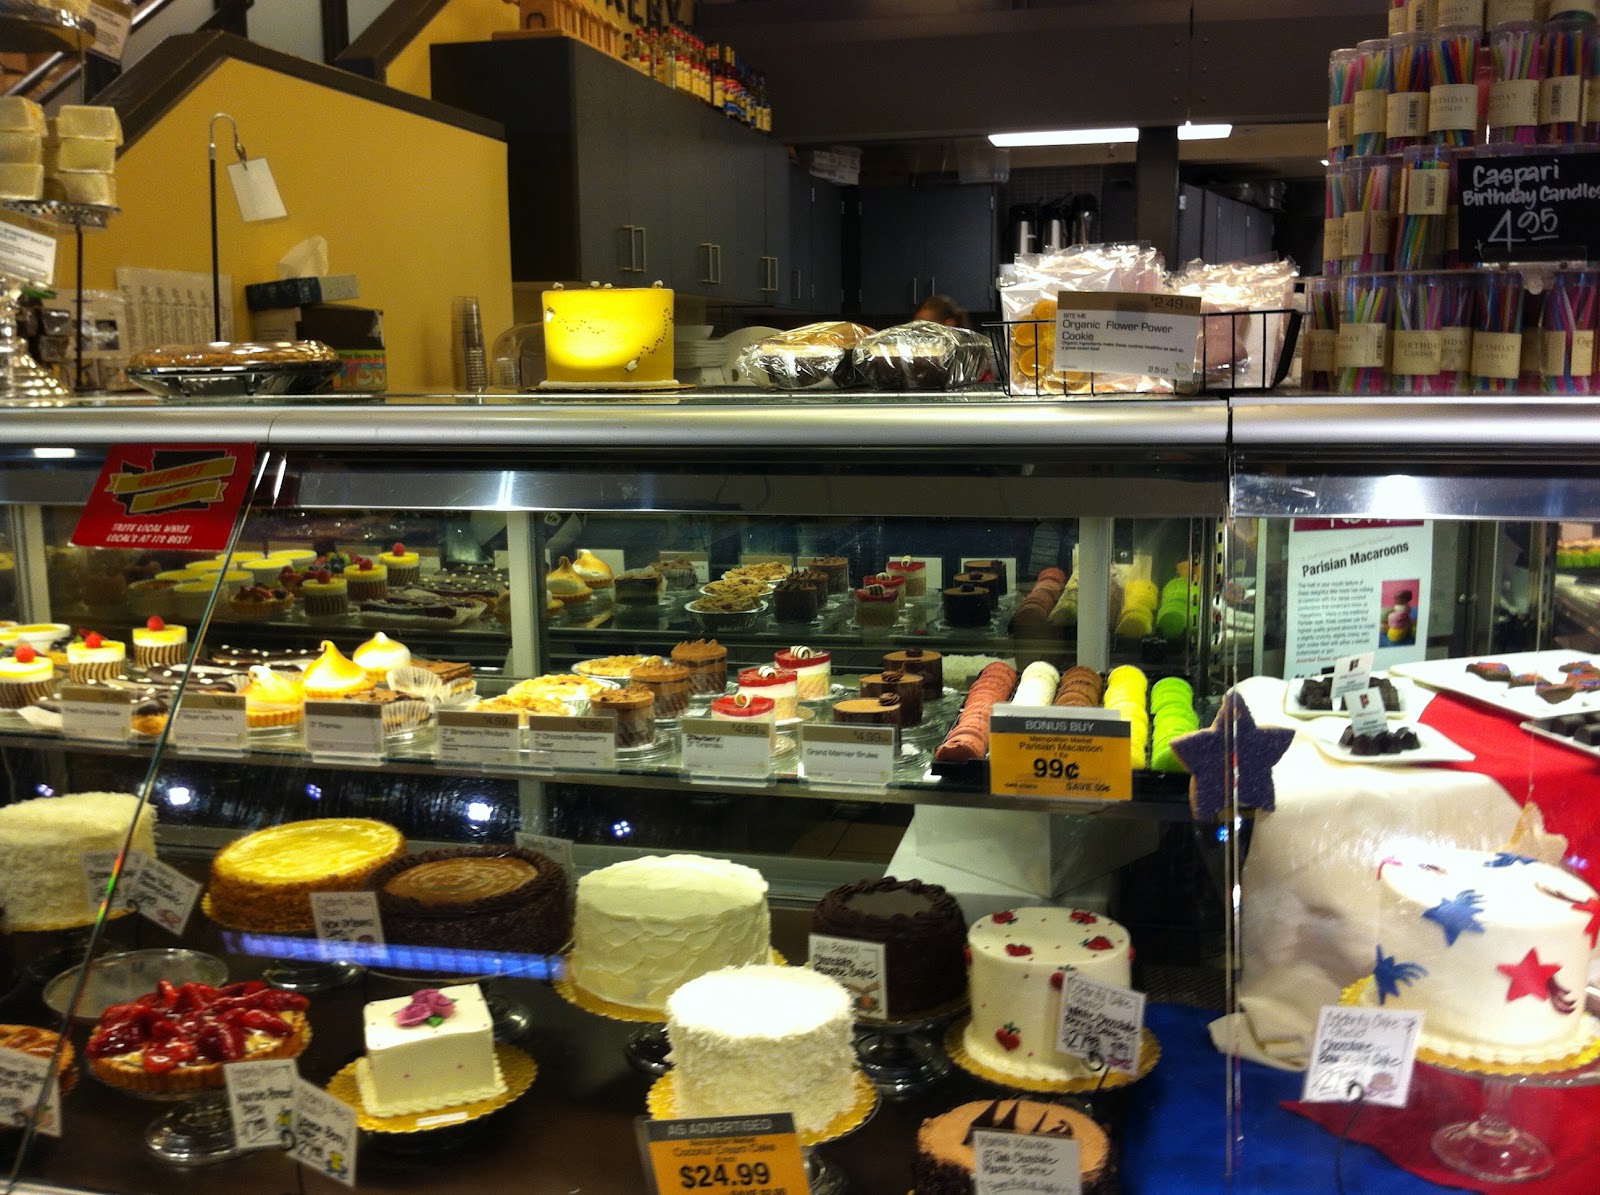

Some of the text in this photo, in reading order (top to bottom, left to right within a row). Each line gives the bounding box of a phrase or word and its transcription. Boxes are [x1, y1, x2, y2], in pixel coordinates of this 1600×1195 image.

[1473, 159, 1560, 192] Caspari
[1463, 188, 1537, 211] Birthday
[1062, 319, 1173, 333] Organic Flower Power
[1062, 330, 1094, 342] Cookie
[1302, 558, 1348, 577] Parisian
[1350, 542, 1409, 566] Macaroons
[1025, 720, 1096, 733] BONUS BUY
[1019, 742, 1056, 751] Parisian
[1033, 757, 1080, 780] 99¢
[1066, 782, 1094, 792] SAVE
[688, 1118, 773, 1135] ADVERTISED
[679, 1162, 770, 1189] $24.99
